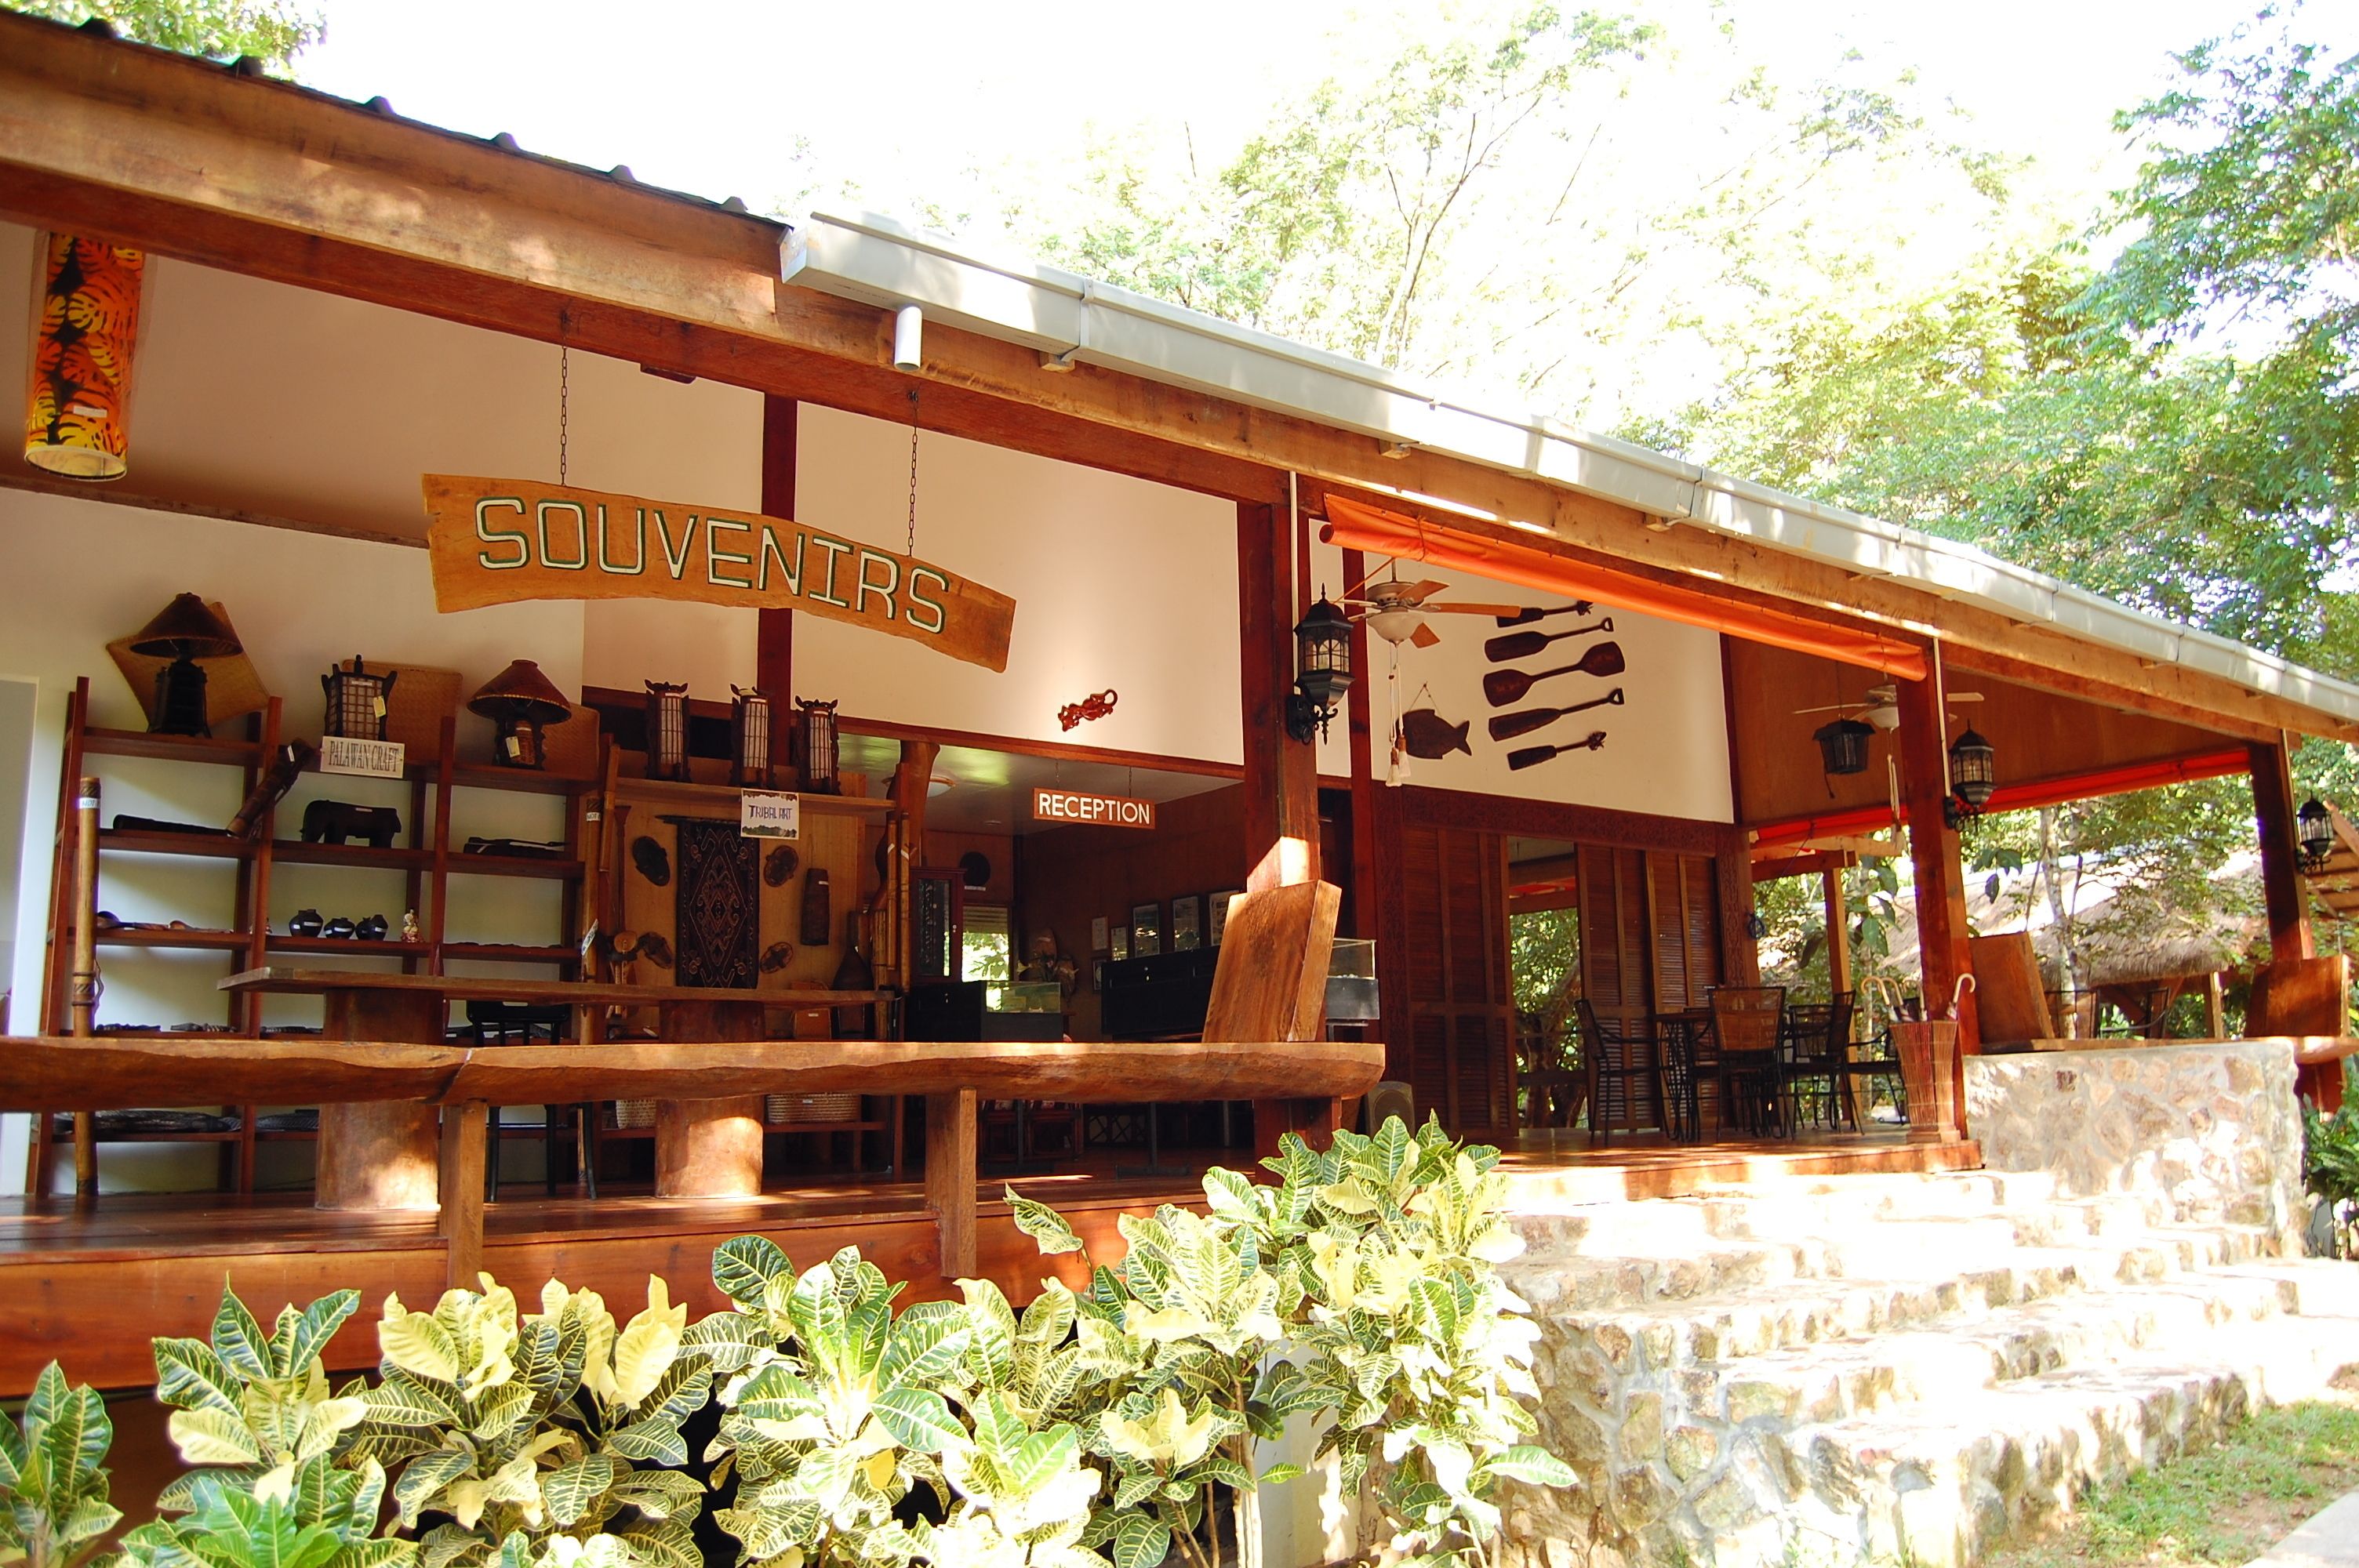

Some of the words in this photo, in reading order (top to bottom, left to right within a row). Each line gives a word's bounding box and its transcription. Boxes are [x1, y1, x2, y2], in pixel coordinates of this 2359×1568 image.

[475, 496, 950, 634] SOUVENIRS
[329, 740, 371, 770] PALAWAN
[372, 745, 399, 772] CRAFT
[748, 804, 777, 820] TRIBAL
[779, 808, 793, 820] ART
[1039, 793, 1150, 825] RECEPTION
